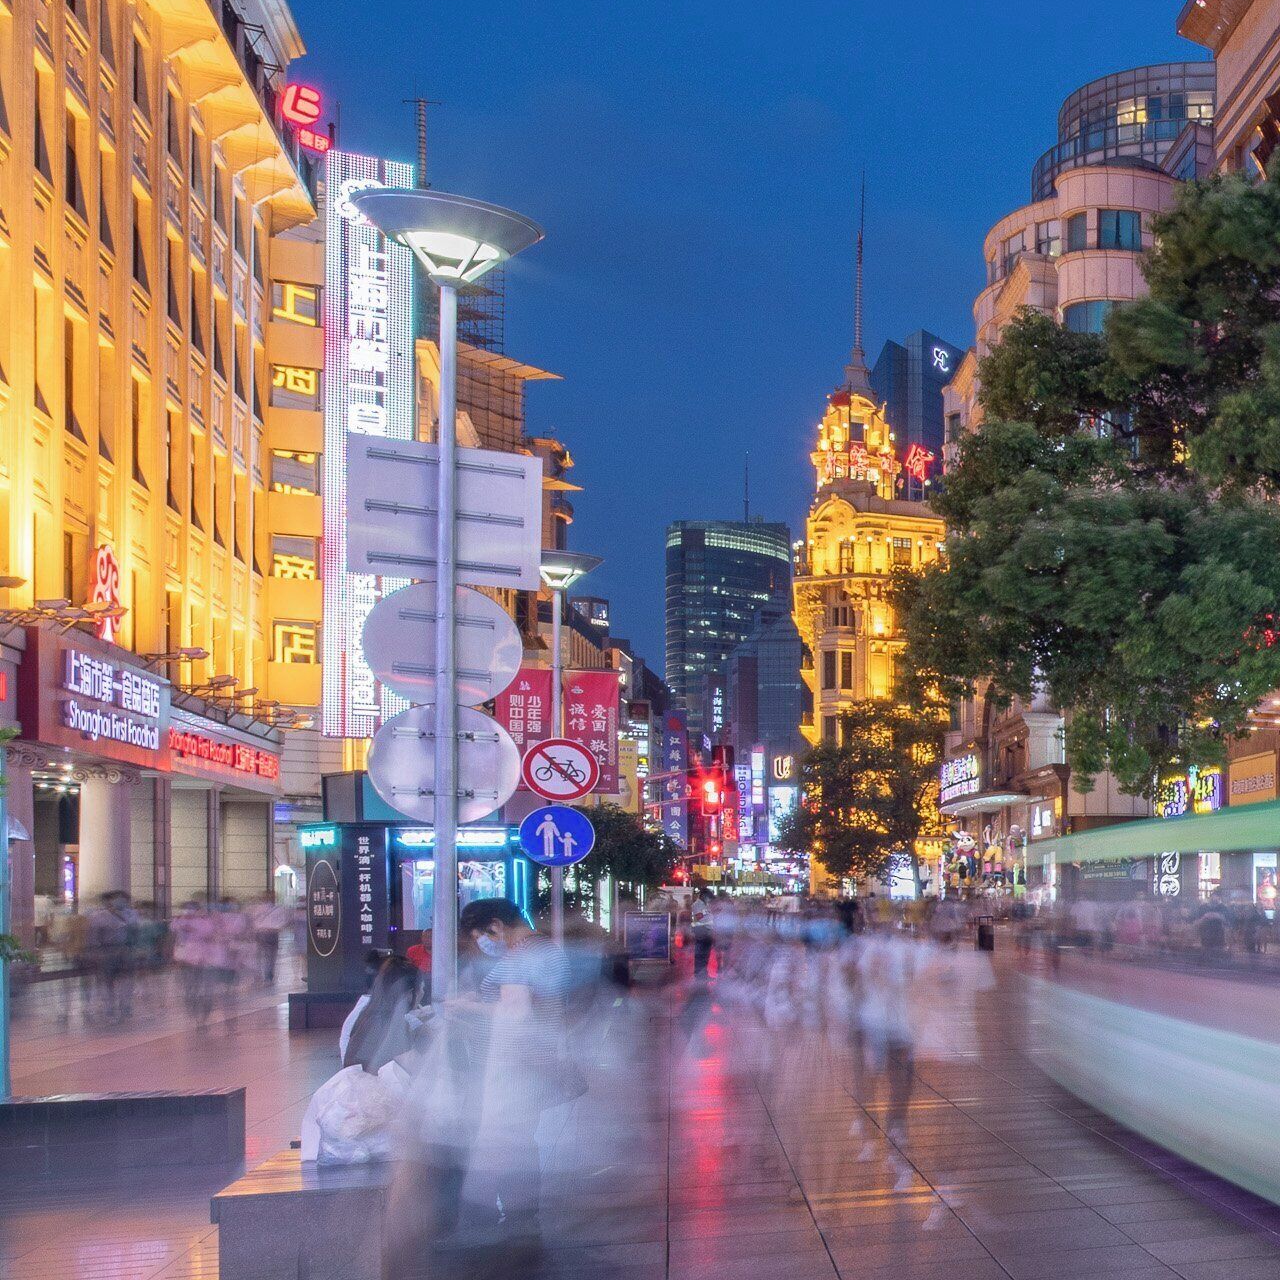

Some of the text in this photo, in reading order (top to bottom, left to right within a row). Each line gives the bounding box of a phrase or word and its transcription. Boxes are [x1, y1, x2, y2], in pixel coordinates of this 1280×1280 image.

[66, 649, 160, 718] 上海市第一食品商店
[69, 699, 160, 751] Shanghai First Foodhall
[509, 694, 524, 745] 则中国强
[527, 696, 542, 733] 少年强
[569, 703, 588, 731] 诚信
[591, 704, 607, 732] 爱国
